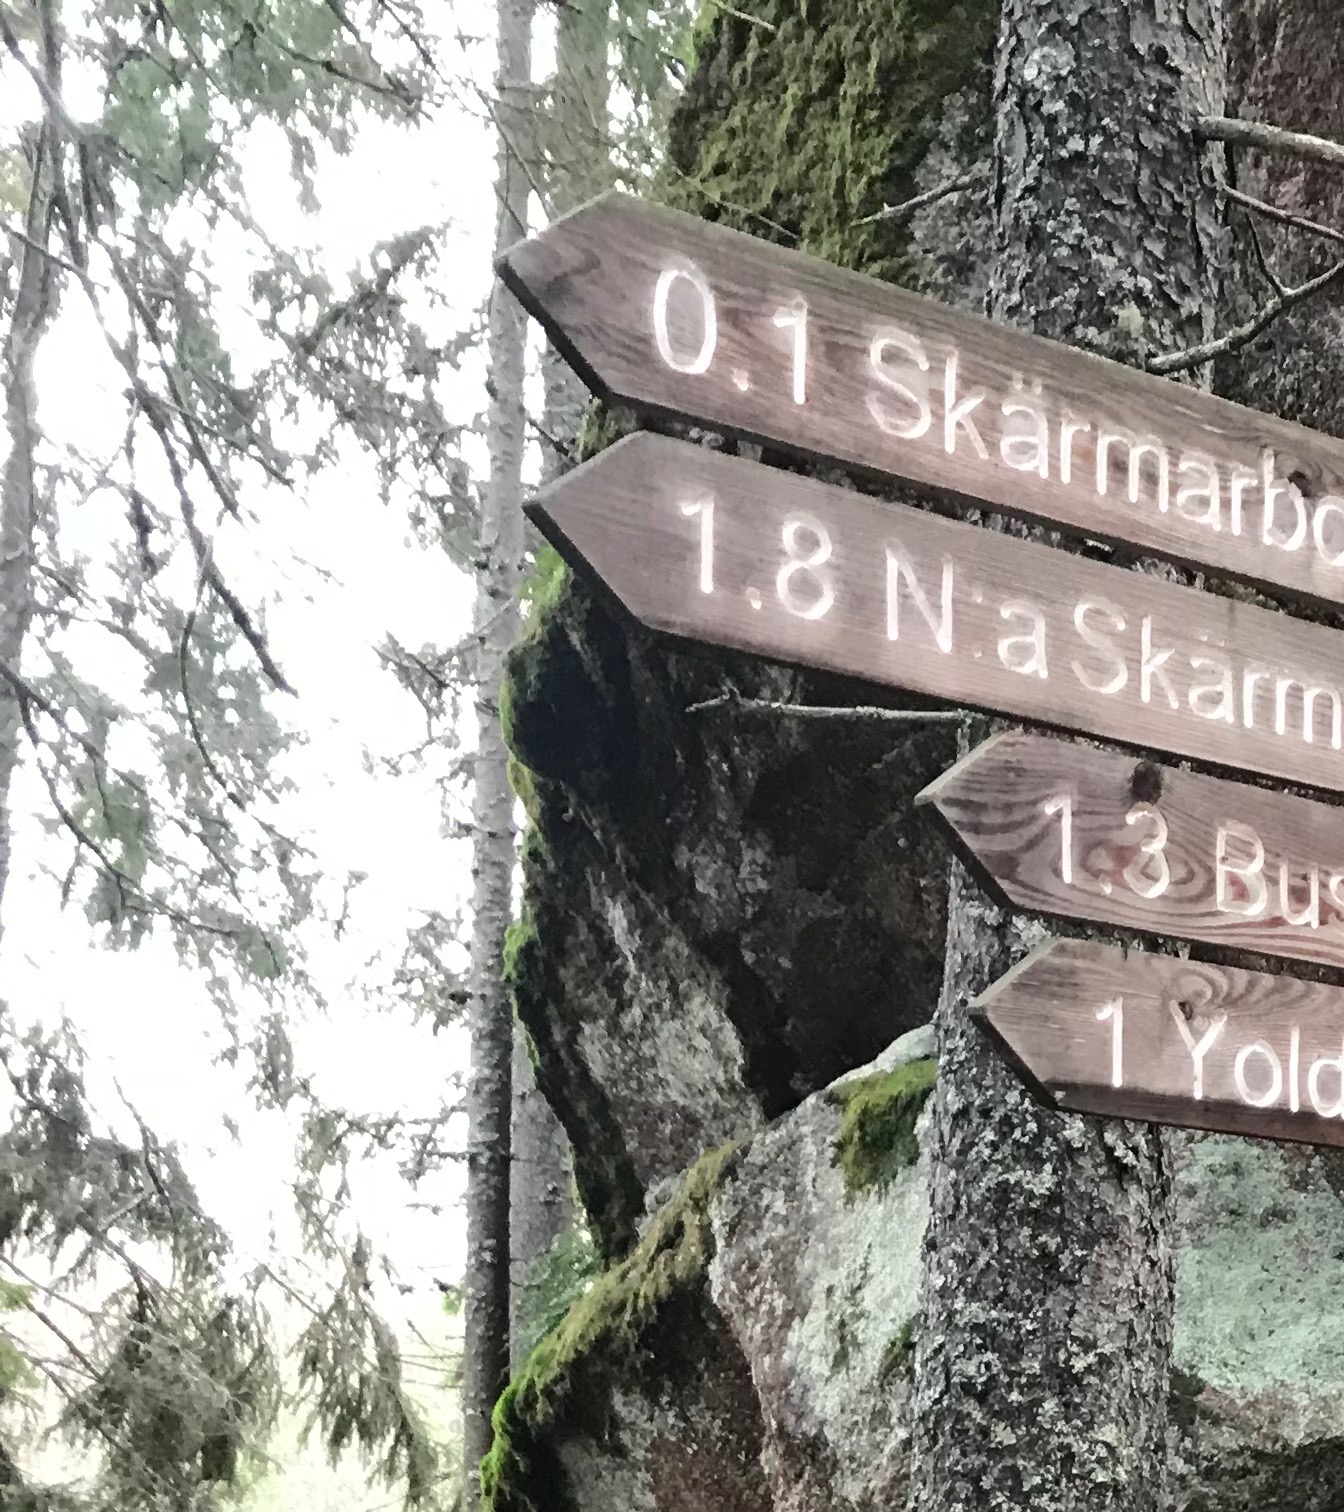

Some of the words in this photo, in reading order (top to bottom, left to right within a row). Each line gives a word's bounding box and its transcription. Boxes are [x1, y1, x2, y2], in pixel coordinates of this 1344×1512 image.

[654, 258, 809, 404] 0.1
[680, 494, 835, 620] 1.8
[1042, 793, 1170, 899] 1.3
[1095, 997, 1125, 1088] 1
